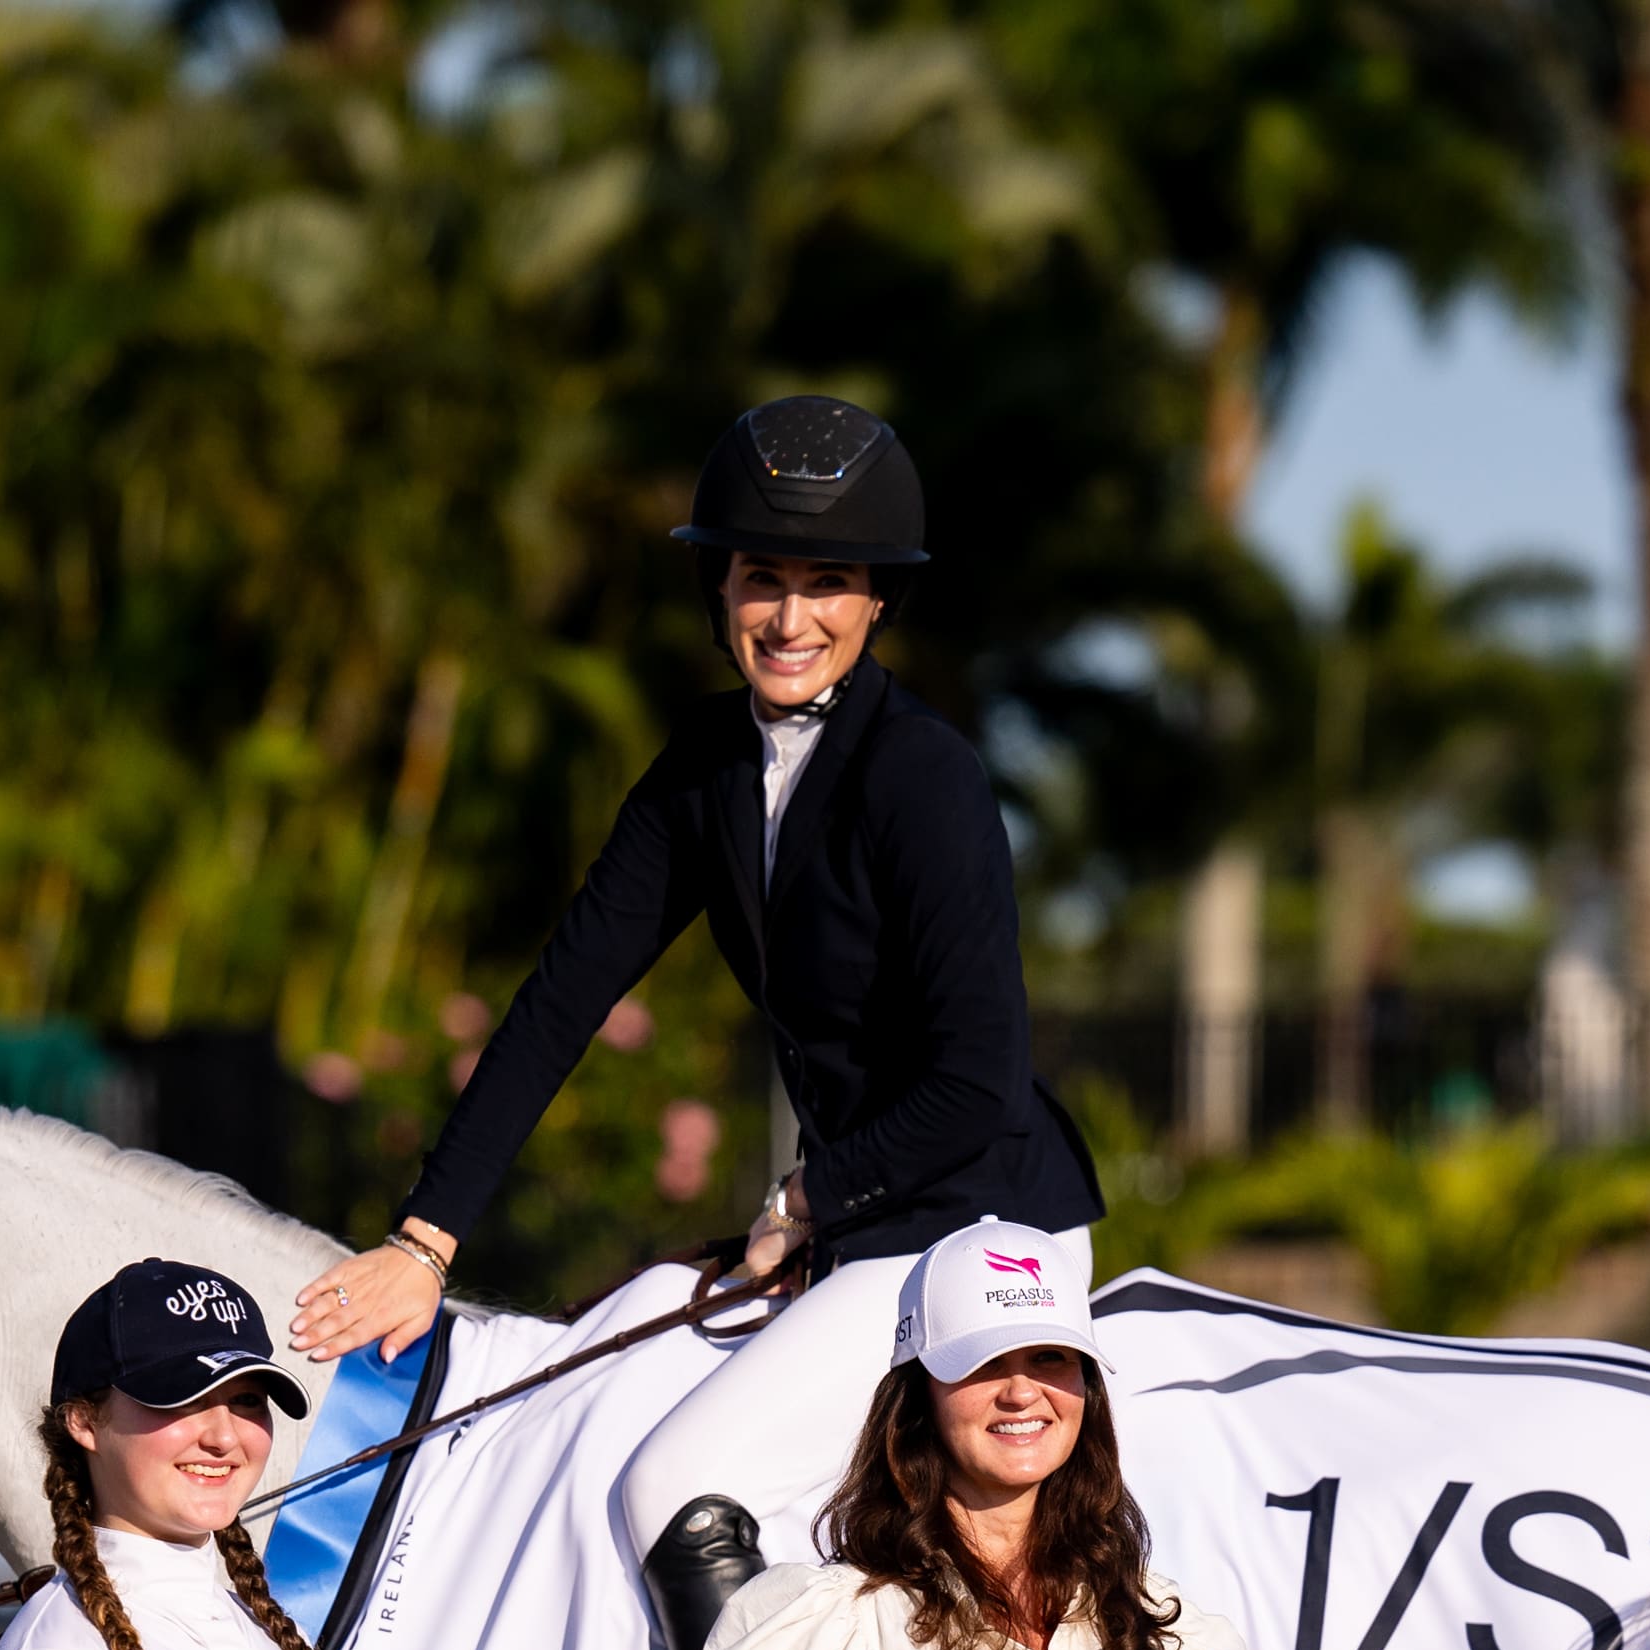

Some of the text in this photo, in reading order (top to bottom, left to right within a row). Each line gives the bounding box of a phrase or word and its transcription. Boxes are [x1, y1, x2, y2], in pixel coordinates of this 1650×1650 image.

[165, 1279, 228, 1322] eyes
[985, 1287, 1055, 1304] PEGASUS
[211, 1296, 248, 1335] up!
